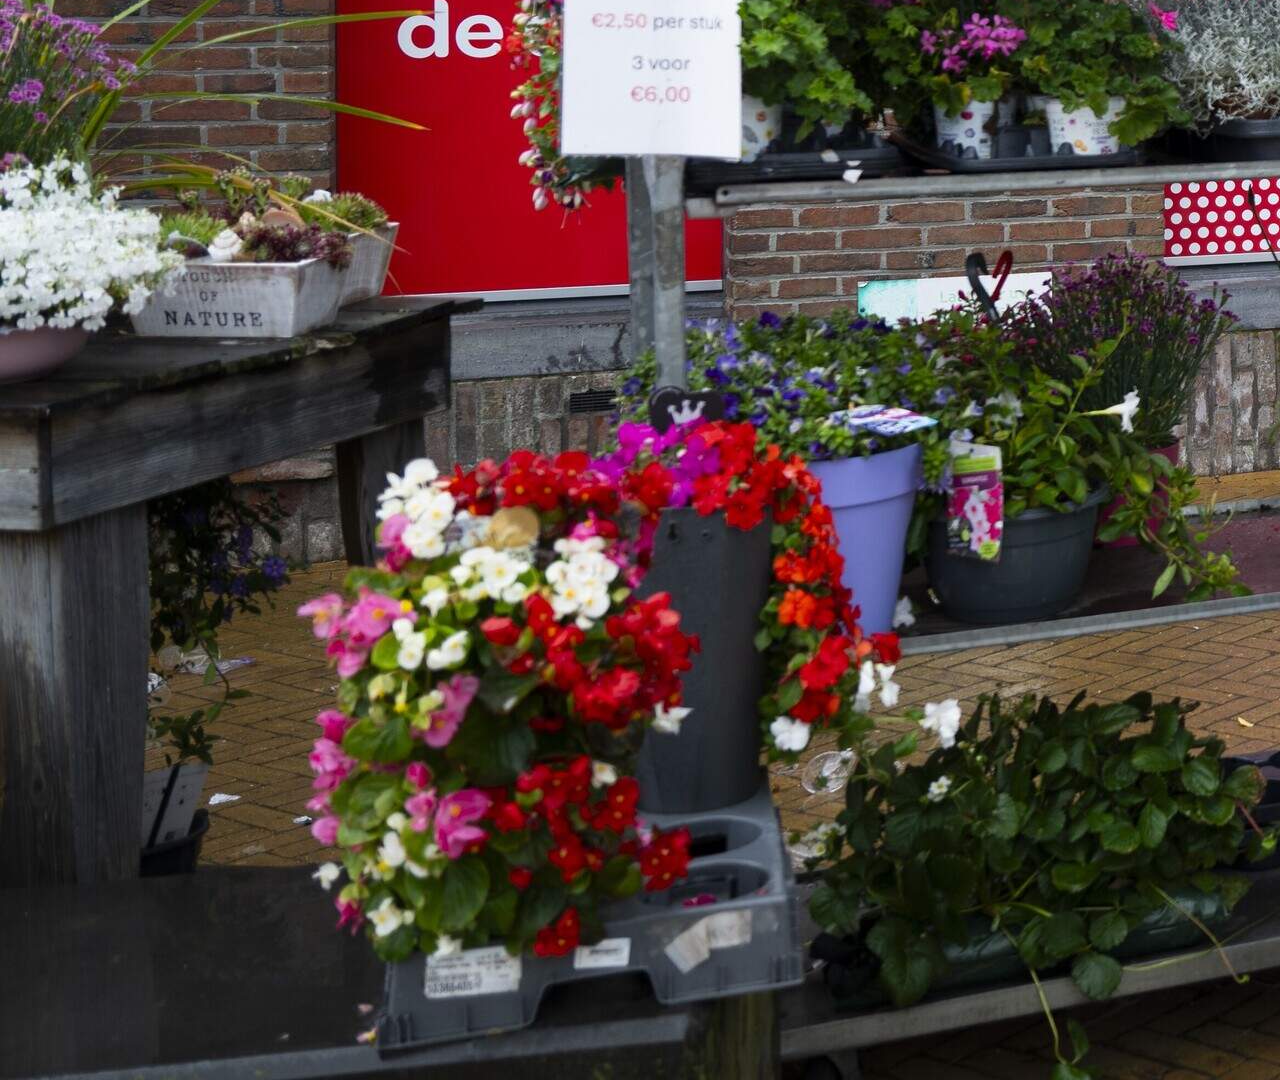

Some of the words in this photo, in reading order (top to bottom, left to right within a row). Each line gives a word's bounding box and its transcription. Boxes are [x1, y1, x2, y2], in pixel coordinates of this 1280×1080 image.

[397, 0, 504, 58] de
[591, 13, 647, 29] €2,50
[653, 19, 684, 30] per
[690, 16, 723, 30] stuk
[632, 56, 643, 71] 3
[649, 58, 690, 71] voor
[630, 86, 691, 102] €6,00
[164, 310, 263, 327] NATURE
